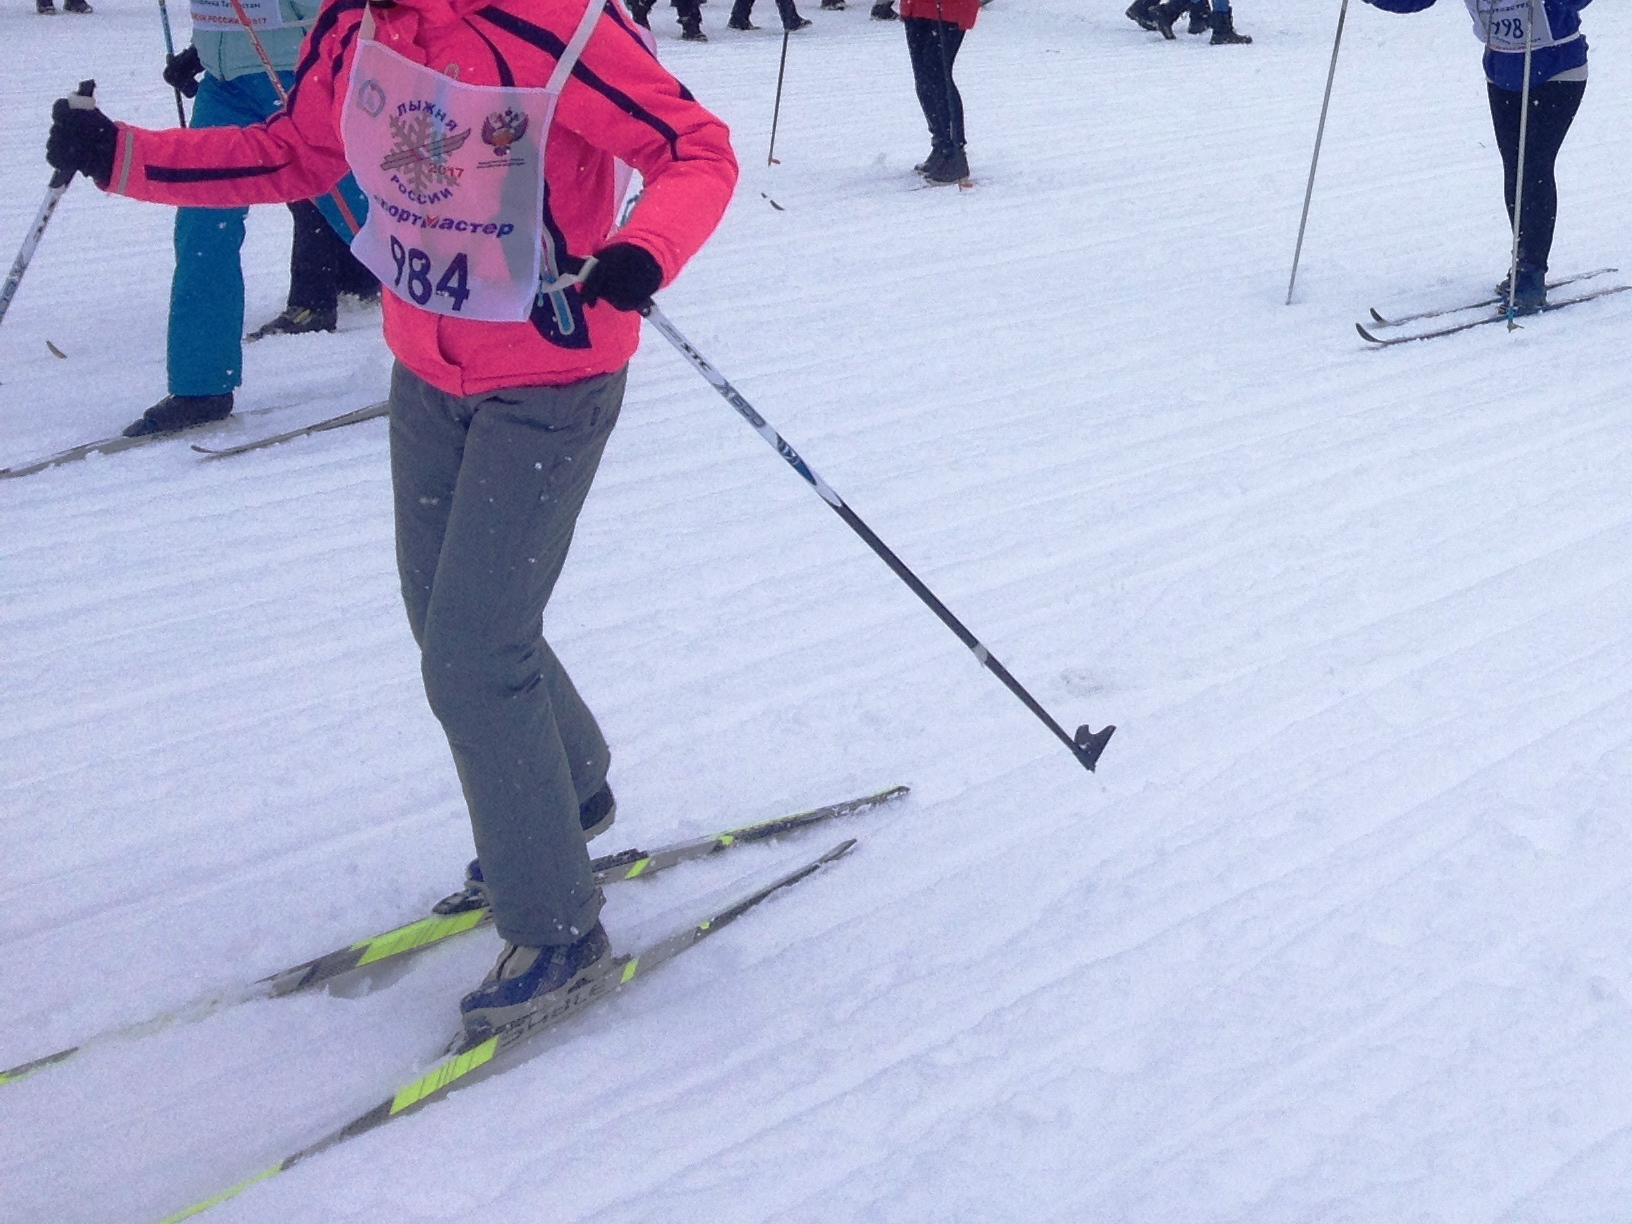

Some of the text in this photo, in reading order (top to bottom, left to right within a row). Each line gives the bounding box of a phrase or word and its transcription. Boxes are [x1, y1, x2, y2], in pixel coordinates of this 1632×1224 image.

[397, 100, 458, 132] ЛЫЖНЯ
[427, 162, 465, 179] 2017
[390, 175, 454, 206] РОССИИ
[390, 234, 470, 312] 984
